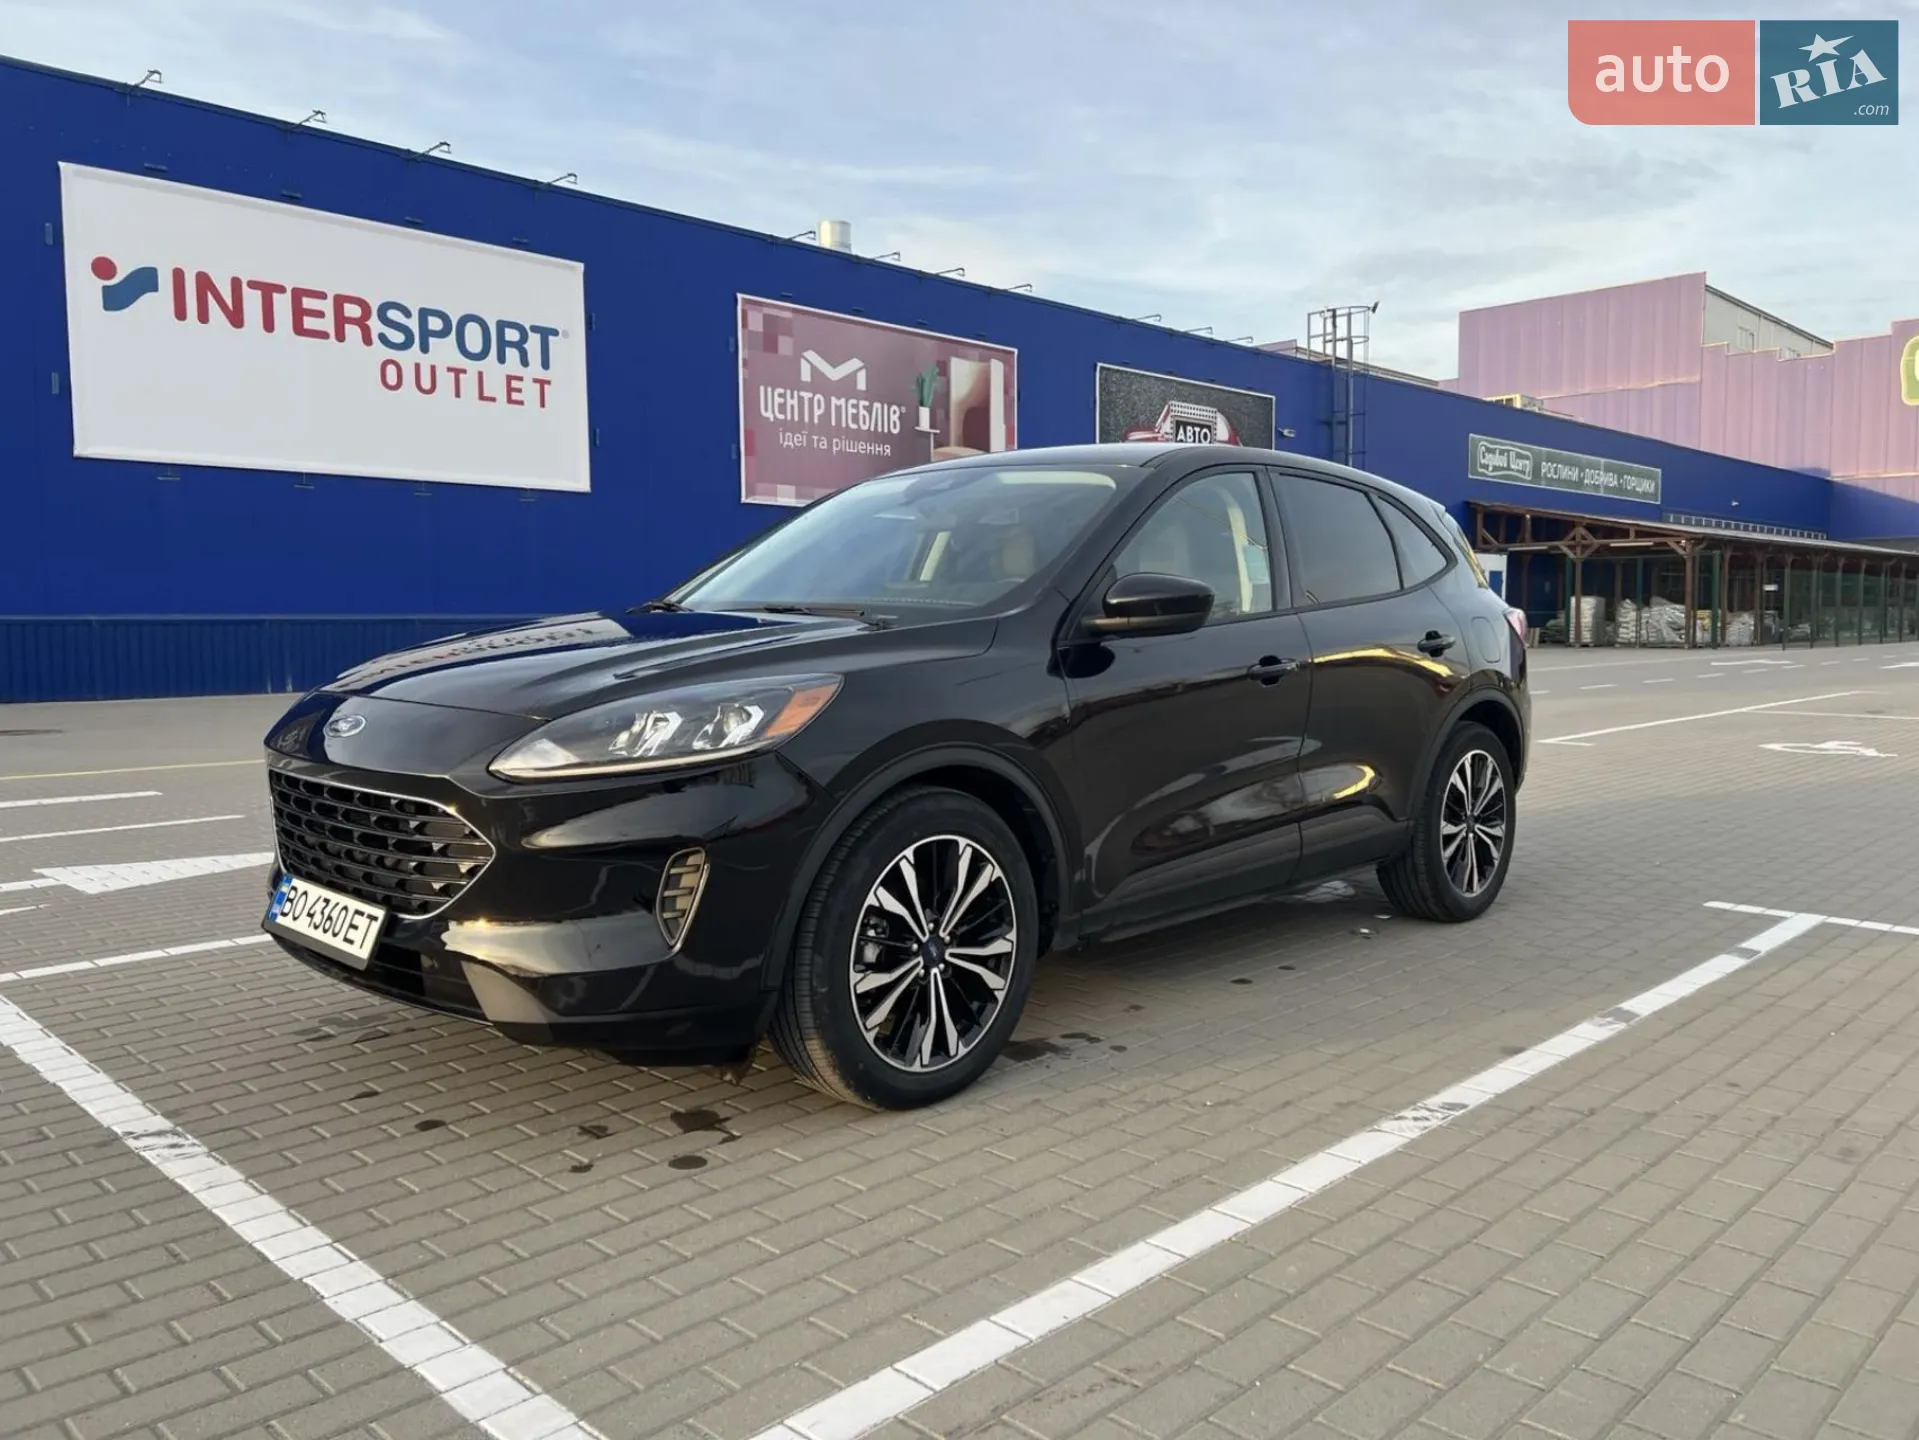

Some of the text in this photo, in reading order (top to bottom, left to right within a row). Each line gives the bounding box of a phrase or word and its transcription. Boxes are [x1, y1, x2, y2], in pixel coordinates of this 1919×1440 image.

[172, 267, 560, 371] INTERSPORT
[379, 358, 552, 408] OUTLET
[759, 384, 901, 435] ЦЕНТР МЕБЛІВ
[778, 427, 892, 456] ідеї та рішення
[1176, 424, 1211, 444] АВТО
[1540, 461, 1579, 482] РОСЛИНИ
